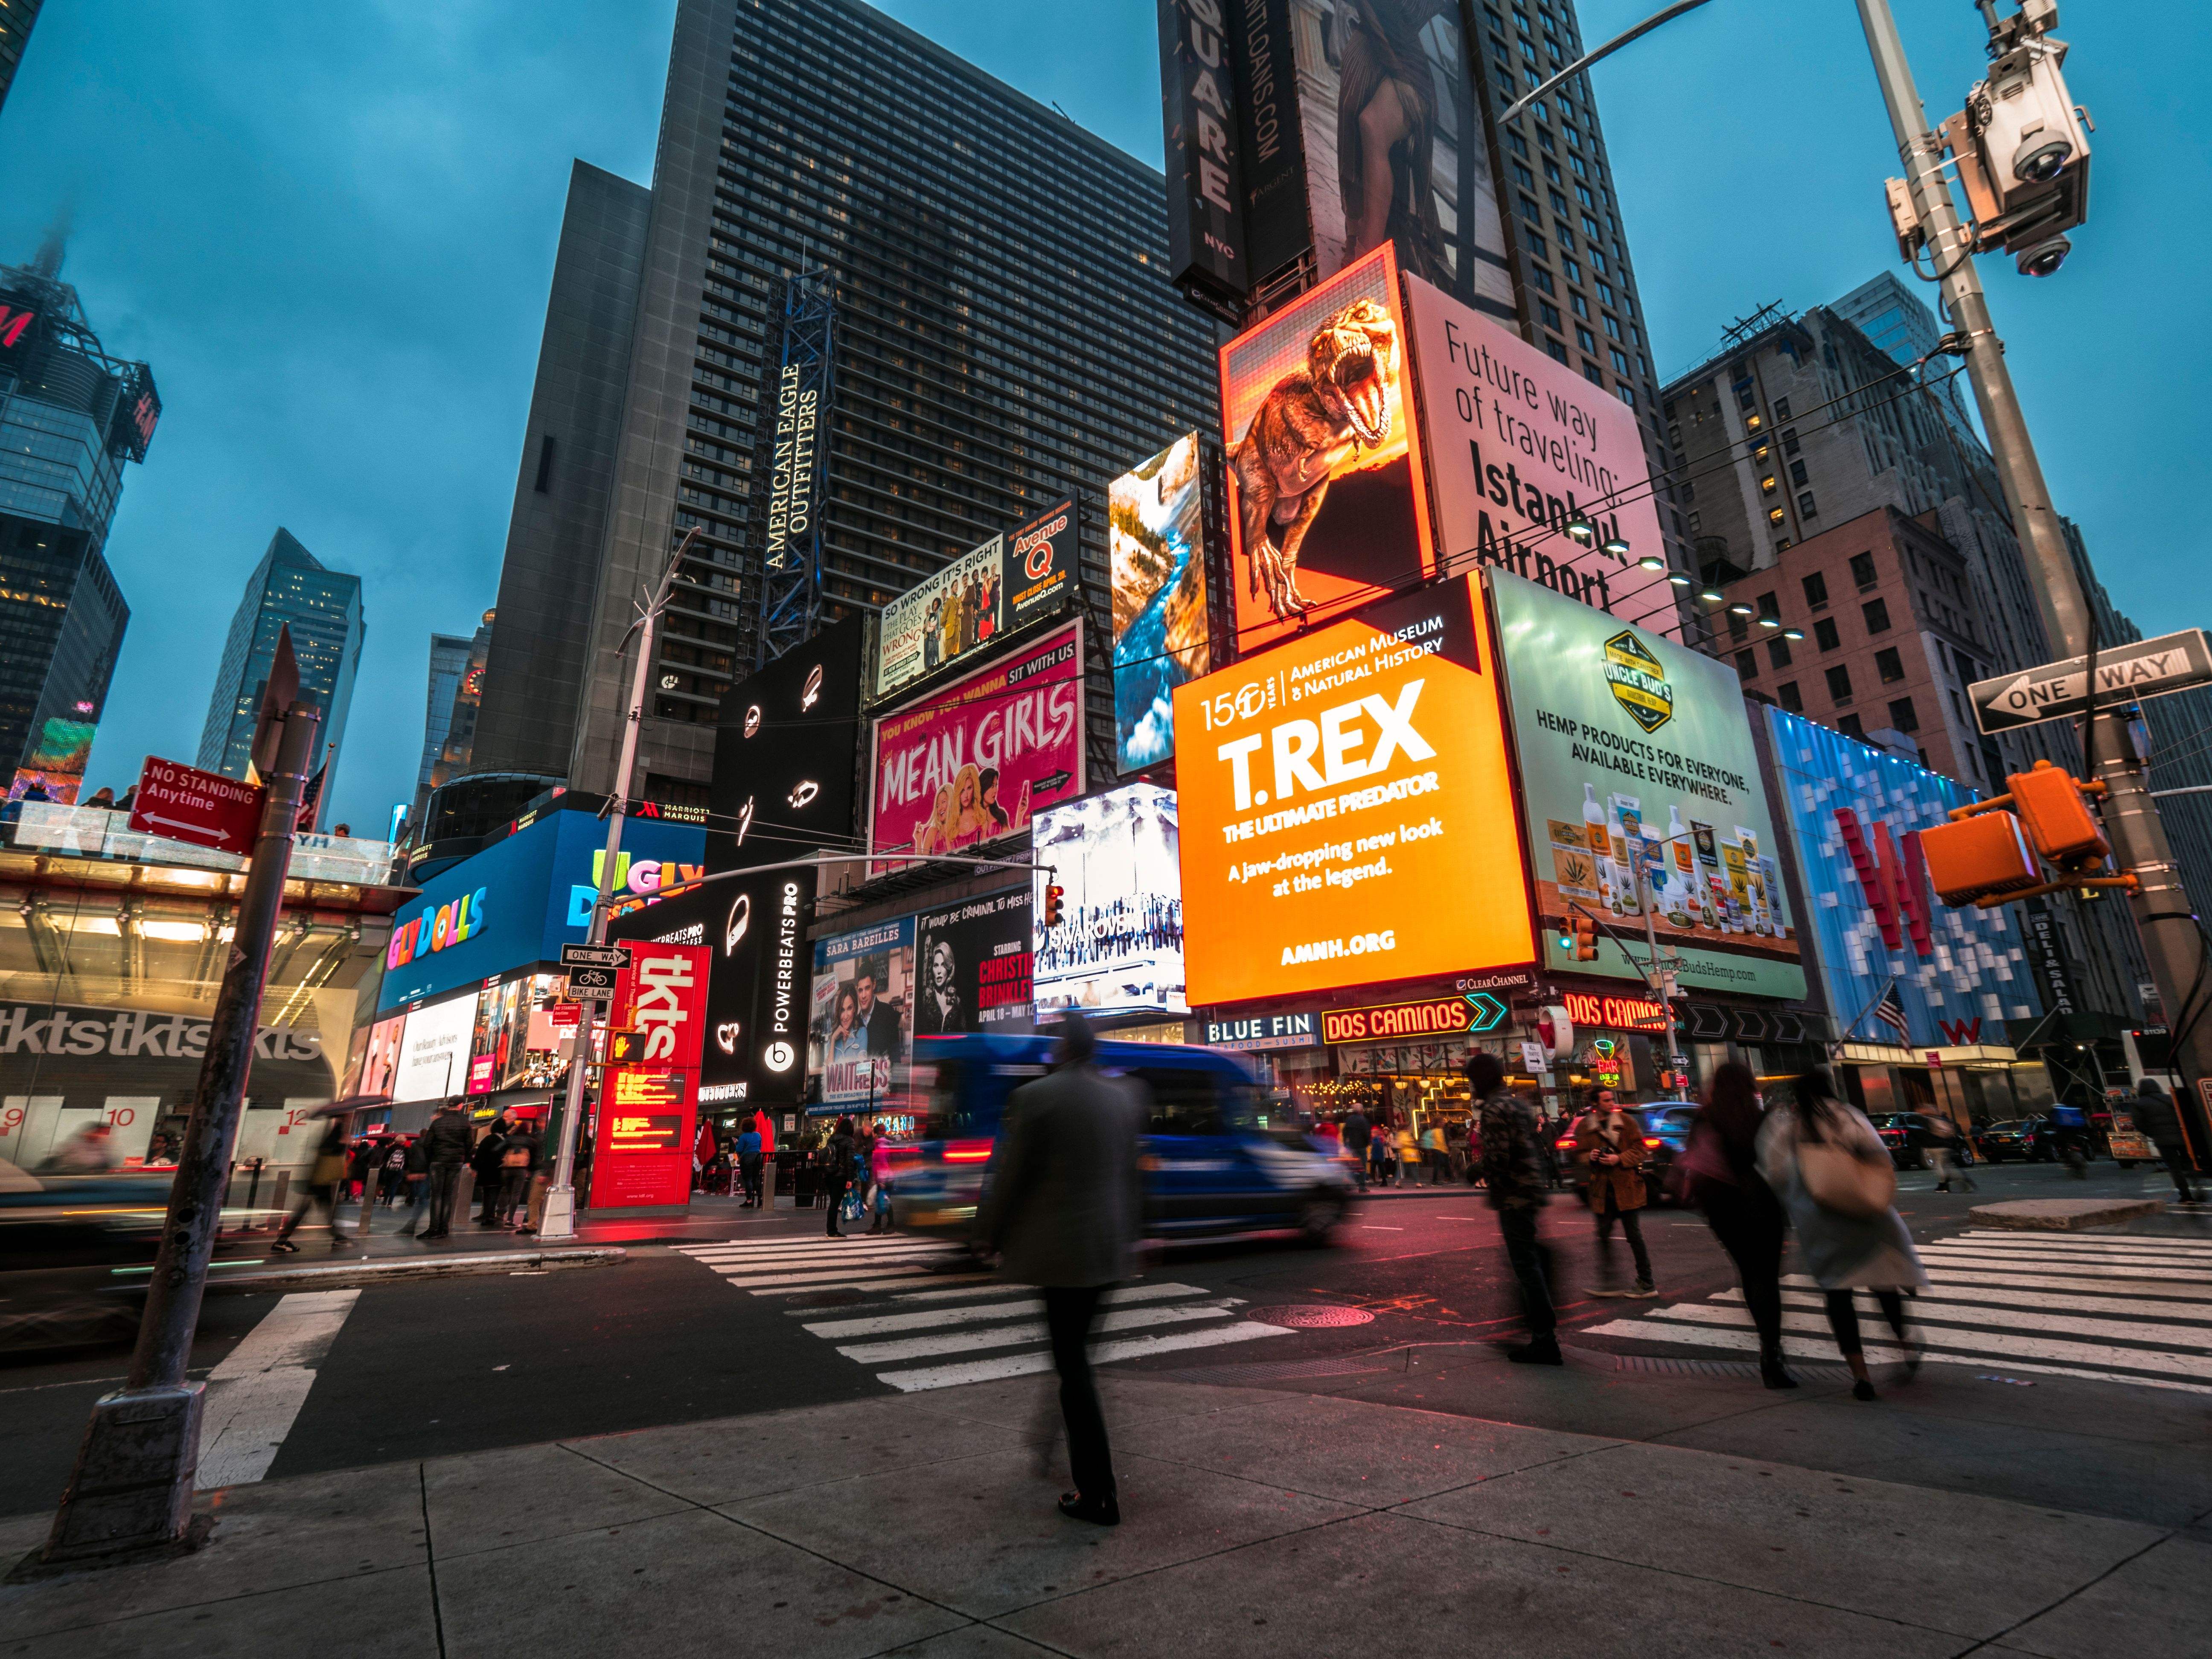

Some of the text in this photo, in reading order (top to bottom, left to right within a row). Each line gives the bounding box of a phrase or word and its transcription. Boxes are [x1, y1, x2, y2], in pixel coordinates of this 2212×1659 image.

[1257, 165, 1295, 198] ARGENT
[1205, 231, 1235, 259] NYC
[1445, 319, 1596, 452] Future way
[1456, 386, 1483, 430] of
[766, 364, 799, 570] AMERICAN EAGLE
[790, 389, 817, 534] OUTFITTERS
[1469, 439, 1628, 567] Istanbul
[1013, 515, 1068, 558] Avenue
[1025, 540, 1053, 579] Q
[1477, 509, 1614, 615] Airport
[885, 540, 1000, 620] SO WRONG IT'S RIGHT
[1013, 593, 1027, 605] MUST
[1027, 582, 1042, 597] CLOSE
[1042, 575, 1057, 589] APRIL
[1016, 582, 1063, 612] AvenueQ.com
[883, 612, 922, 642] THAT GOES
[887, 602, 919, 631] THE PLAY
[882, 628, 922, 656] WRONG
[1290, 616, 1444, 682] AMERICAN MUSEUM
[1610, 650, 1624, 662] MADE
[1625, 658, 1636, 667] WITH
[1009, 643, 1074, 684] SIT WITH US.
[1304, 637, 1443, 698] NATURAL HISTORY
[1604, 663, 1639, 687] UNCLE
[1266, 676, 1276, 710] YEARS
[1626, 689, 1647, 704] INDUSTRIAL
[2008, 679, 2071, 710] ONE
[2099, 654, 2170, 688] WAY
[882, 675, 1007, 742] YOU KNOW YOU WANNA
[882, 682, 1074, 814] MEAN GIRLS
[1217, 678, 1437, 812] T.REX
[1536, 709, 1750, 795] HEMP PRODUCTS FOR EVERYONE,
[151, 766, 254, 804] NO STANDING
[1572, 742, 1732, 806] AVAILABLE EVERYWHERE.
[147, 783, 215, 811] Anytime
[664, 804, 710, 815] MARRIOTT
[1222, 771, 1440, 844] THE ULTIMATE PREDATOR
[518, 809, 537, 824] MARRIOTT
[518, 818, 534, 831] MARQUIS
[664, 811, 705, 822] MARQUIS
[1228, 817, 1444, 884] A jaw-dropping new look
[592, 849, 704, 897] UGLY
[1272, 856, 1393, 897] at the legend.
[921, 895, 1023, 931] IT WOULD BE CRIMINAL TO MISS
[572, 951, 622, 962] ONE WAY
[827, 942, 849, 957] SARA
[852, 928, 899, 950] BAREILLES
[993, 940, 1022, 956] STARRING
[1280, 930, 1396, 966] AMNH.ORG
[2035, 922, 2073, 1015] DELI & SALAD
[571, 987, 611, 997] BIKE LANE
[634, 954, 694, 1060] tkts
[978, 978, 1033, 1009] BRINKLEY
[978, 1003, 1034, 1023] APRIL 18 MAY 12
[1327, 1002, 1467, 1039] DOS CAMINOS
[1566, 994, 1602, 1025] DOS
[1208, 1014, 1310, 1042] BLUE FIN
[1275, 1036, 1310, 1045] SUSHI
[1938, 1017, 1982, 1045] W
[1597, 1059, 1619, 1074] BAR
[3, 1108, 23, 1127] 9
[106, 1108, 135, 1126] 10
[285, 1109, 308, 1126] 12
